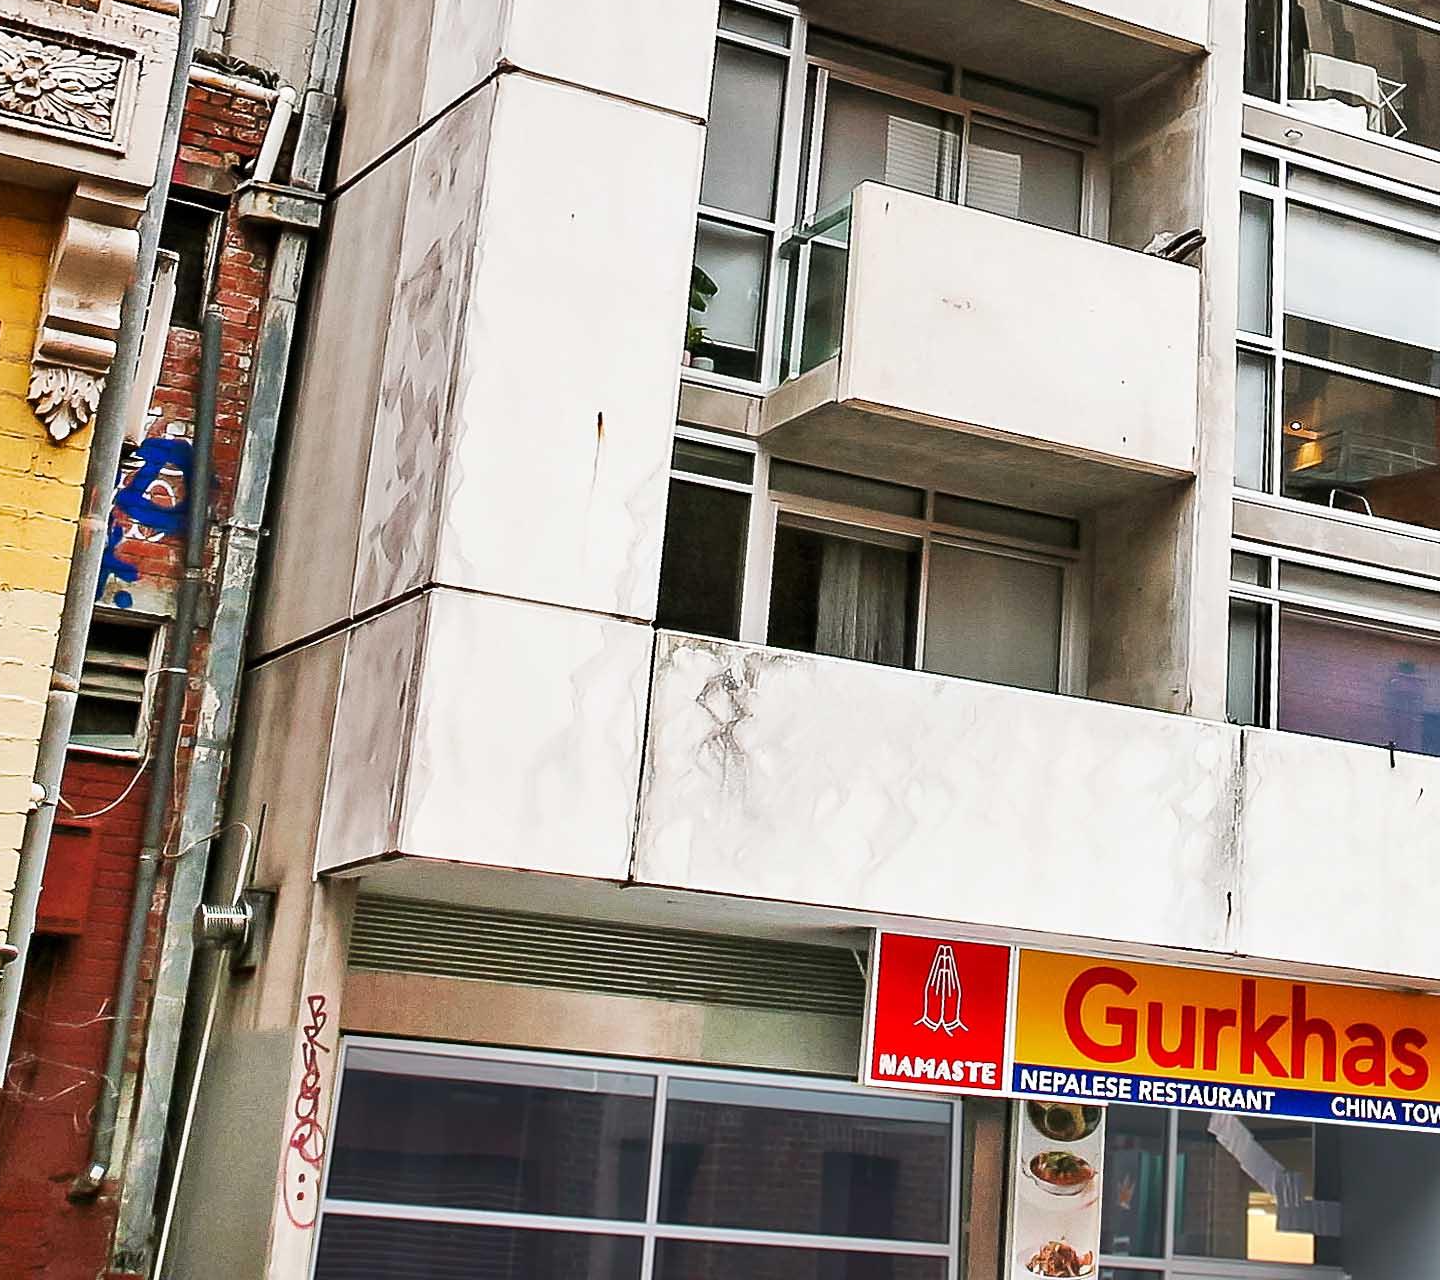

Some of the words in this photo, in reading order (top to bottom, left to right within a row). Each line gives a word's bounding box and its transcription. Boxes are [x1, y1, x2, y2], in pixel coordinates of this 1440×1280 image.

[1063, 966, 1430, 1091] Gurkhas
[878, 1053, 997, 1085] NAMASTE
[1020, 1068, 1132, 1100] NEPALESE
[1138, 1079, 1276, 1111] RESTAURANT
[1330, 1096, 1396, 1121] CHINA
